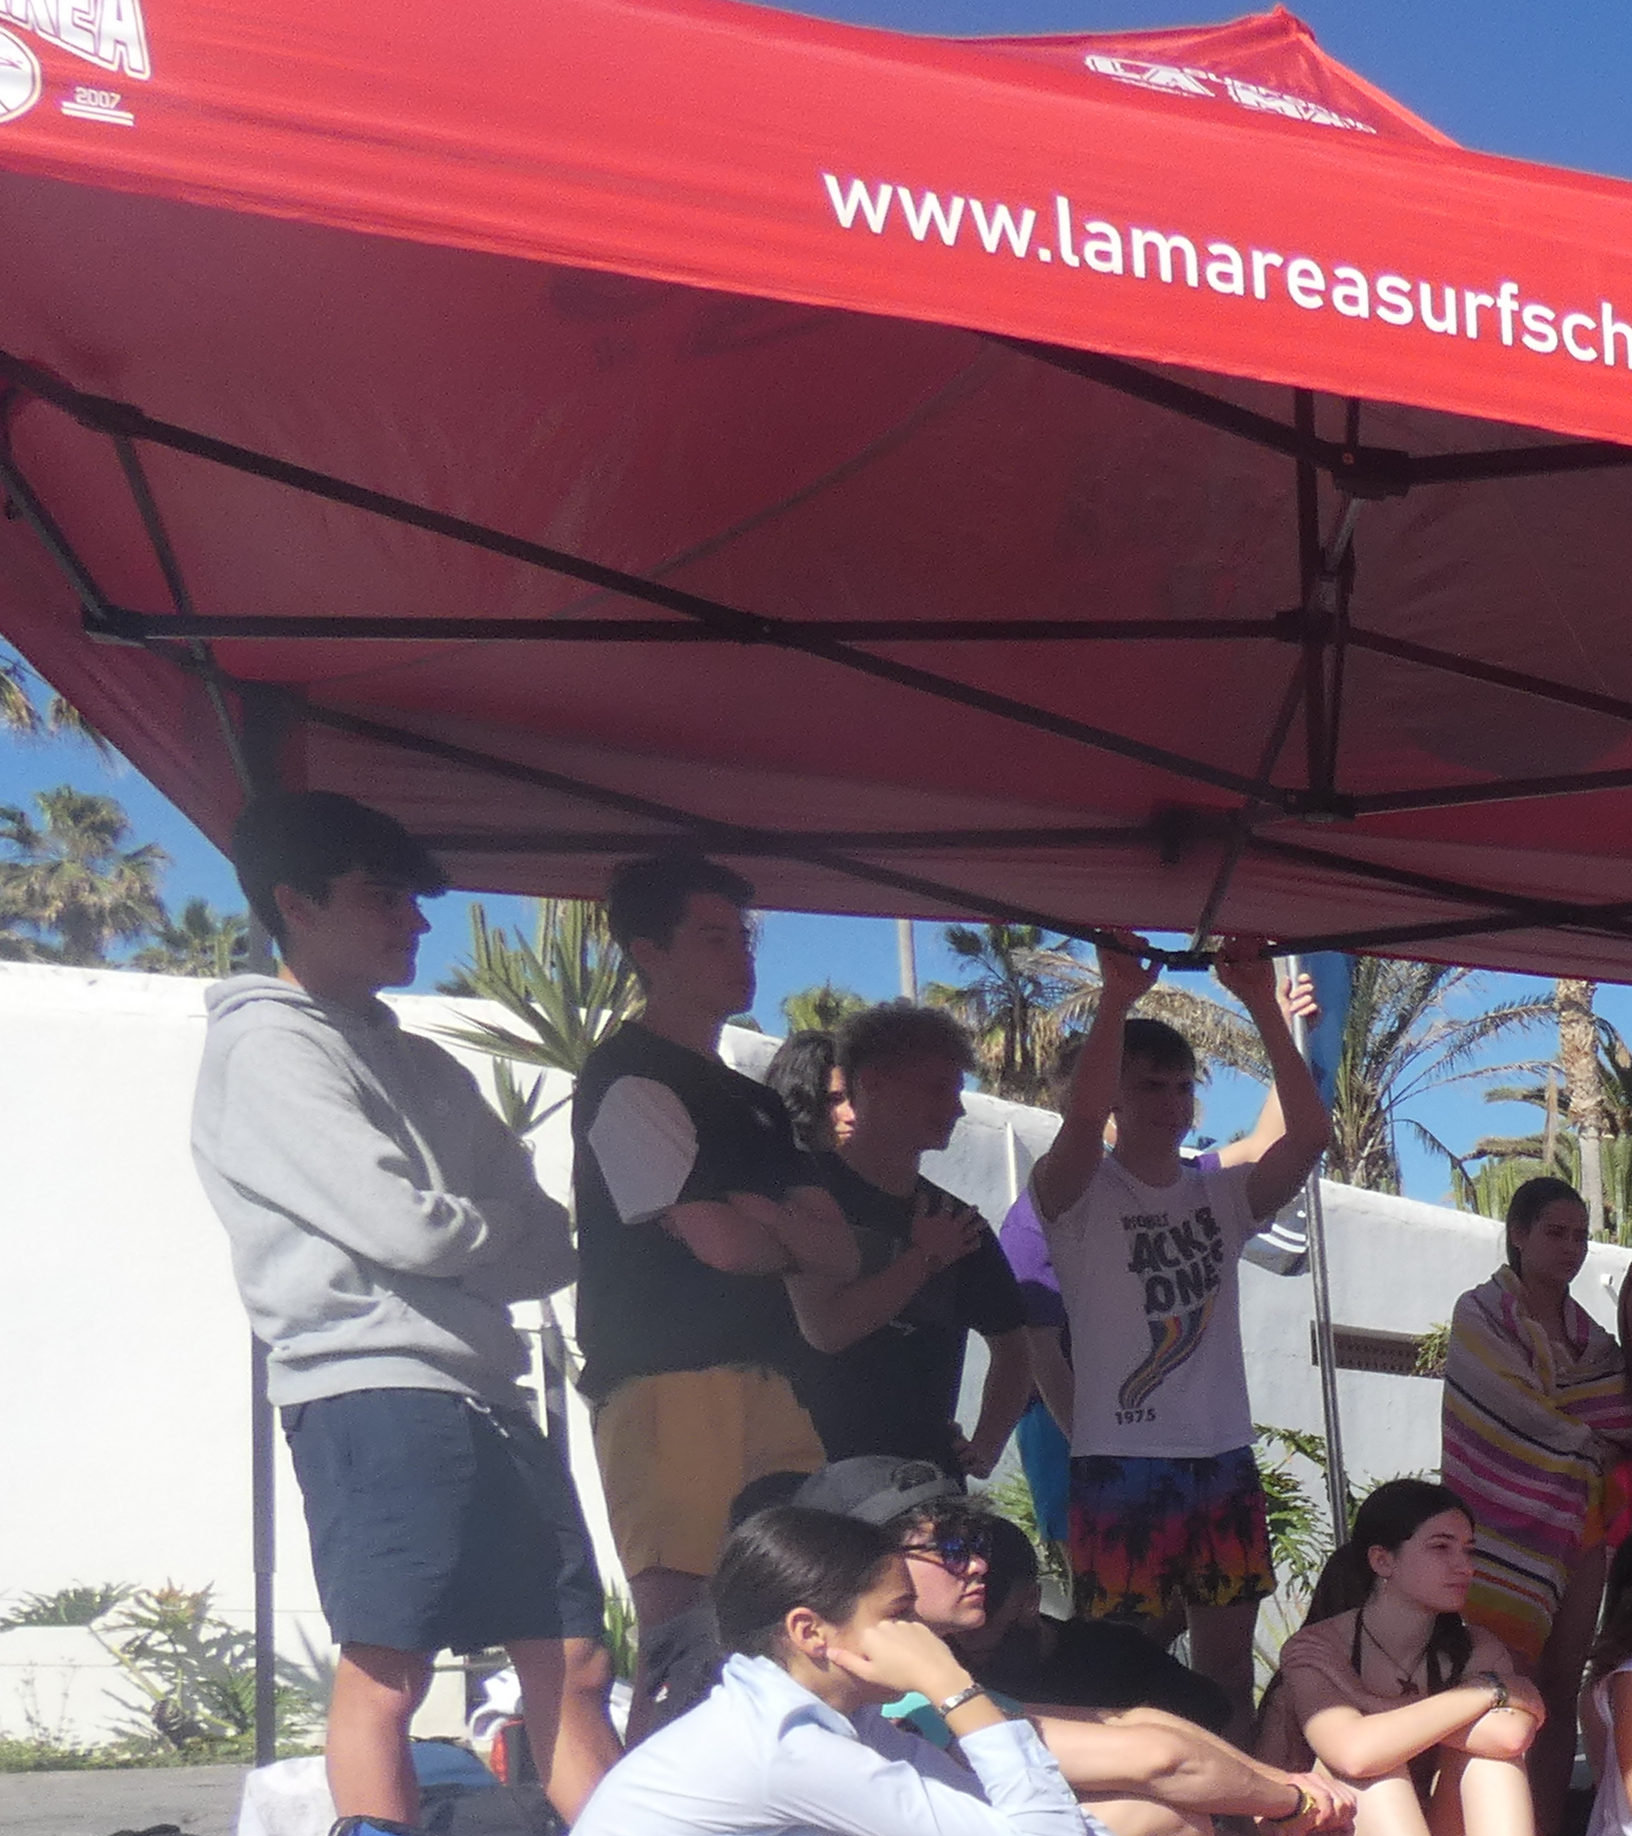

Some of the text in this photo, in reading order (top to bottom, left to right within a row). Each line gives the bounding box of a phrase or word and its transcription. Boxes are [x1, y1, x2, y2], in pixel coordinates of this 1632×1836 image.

[75, 86, 122, 109] 2007
[1128, 1219, 1207, 1274] ACK
[1115, 1407, 1157, 1426] 1975
